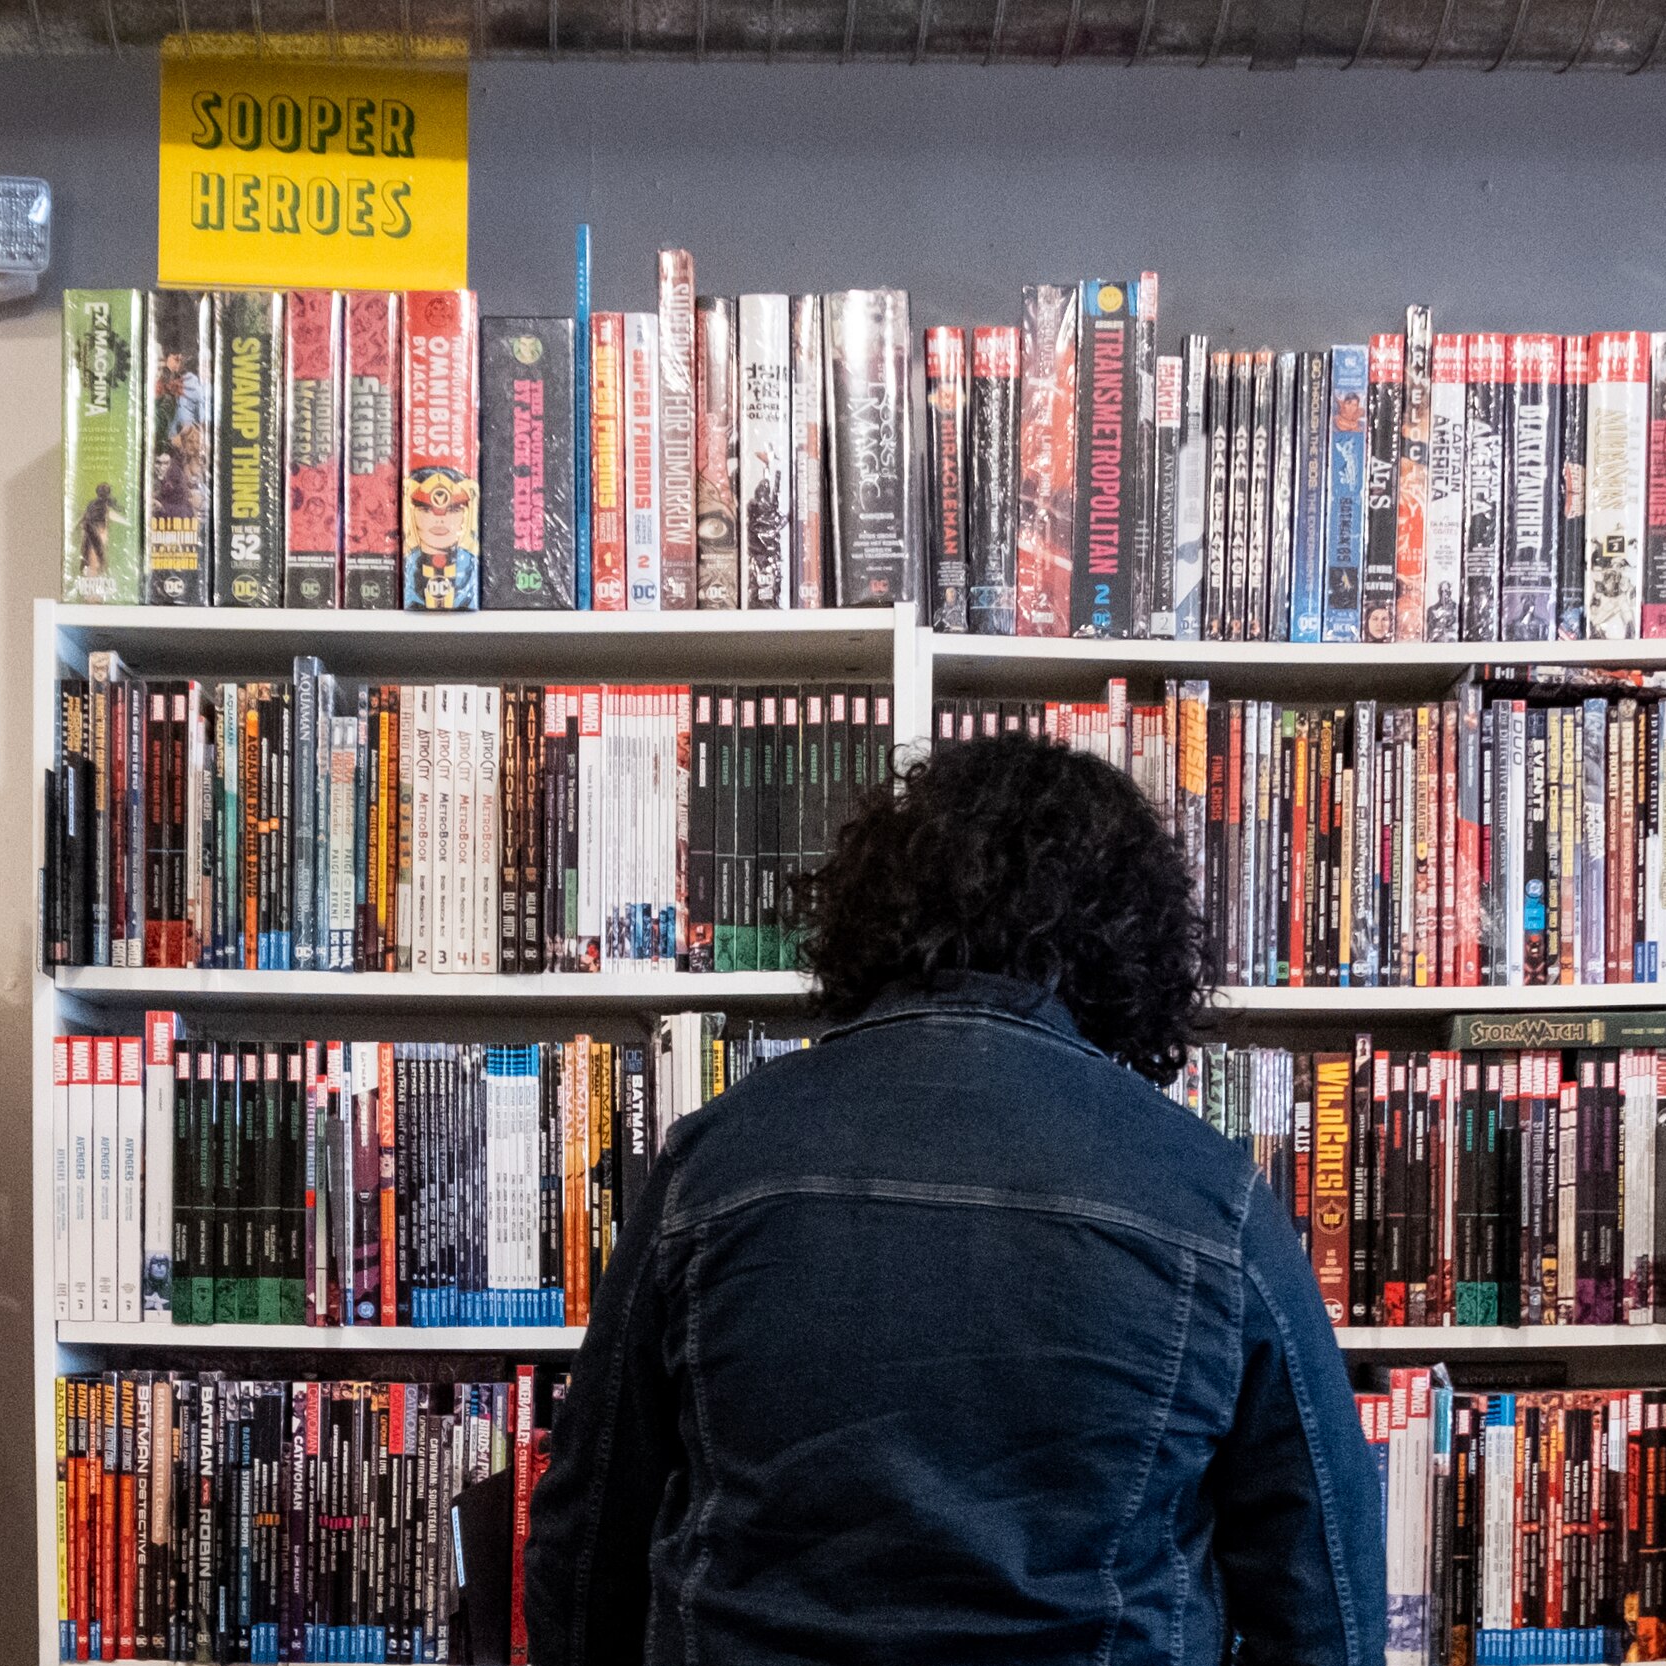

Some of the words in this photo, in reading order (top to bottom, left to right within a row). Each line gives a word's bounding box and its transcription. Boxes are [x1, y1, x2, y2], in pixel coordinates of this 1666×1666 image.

[192, 91, 416, 158] SOOPER
[190, 172, 413, 239] HEROES
[231, 336, 261, 446] SWAMP
[428, 336, 450, 457] OMNIBUS
[230, 448, 261, 519] THING
[943, 418, 958, 555] MIRACLEMAN
[1088, 329, 1124, 576] TRANSMETROPOLITAN
[231, 534, 261, 561] 52
[300, 672, 311, 741] AQUAMAN
[1469, 1017, 1584, 1047] STORMWATCH
[137, 1386, 150, 1473] BATMAN
[200, 1387, 213, 1475] BATMAN
[293, 1436, 303, 1510] CATWOMAN
[138, 1478, 147, 1564] DETECTIVE
[199, 1508, 211, 1577] ROBIN
